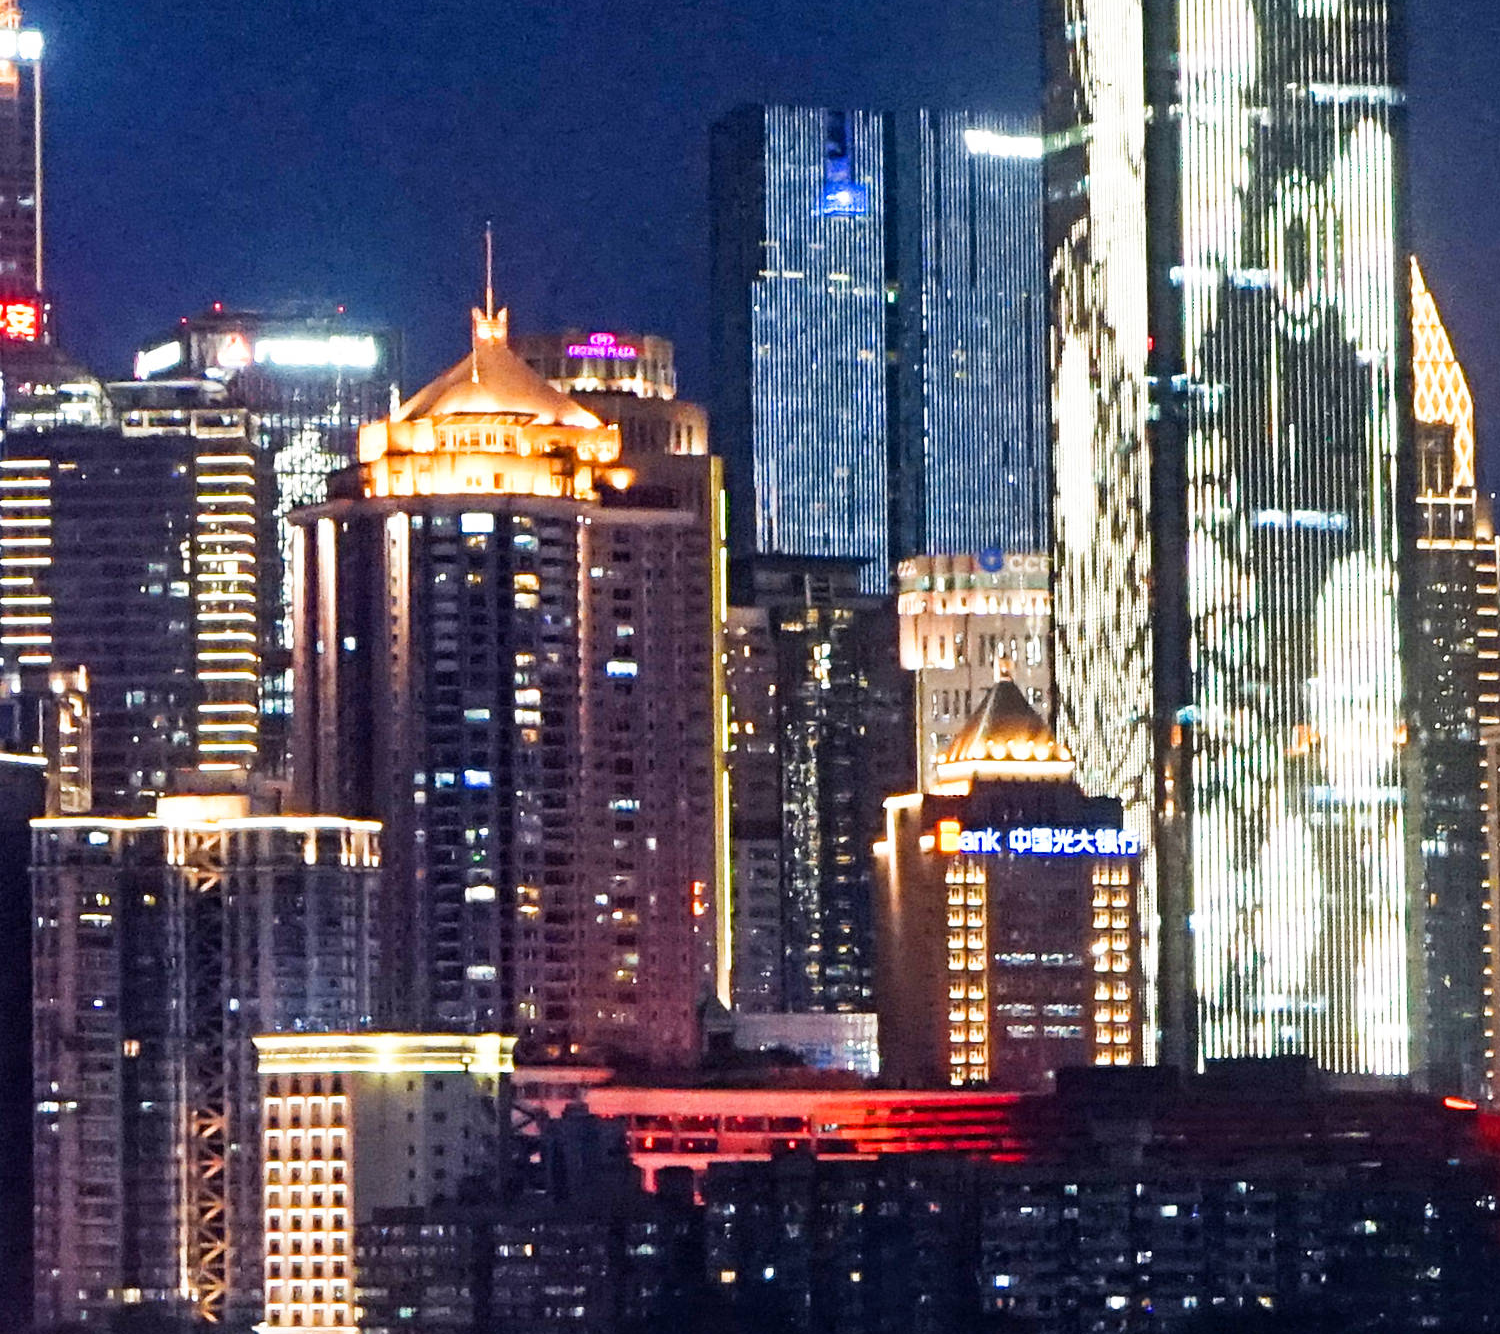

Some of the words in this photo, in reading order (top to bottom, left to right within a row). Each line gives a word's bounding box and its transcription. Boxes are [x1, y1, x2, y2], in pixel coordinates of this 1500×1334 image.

[1009, 827, 1140, 854] 中国光大银行
